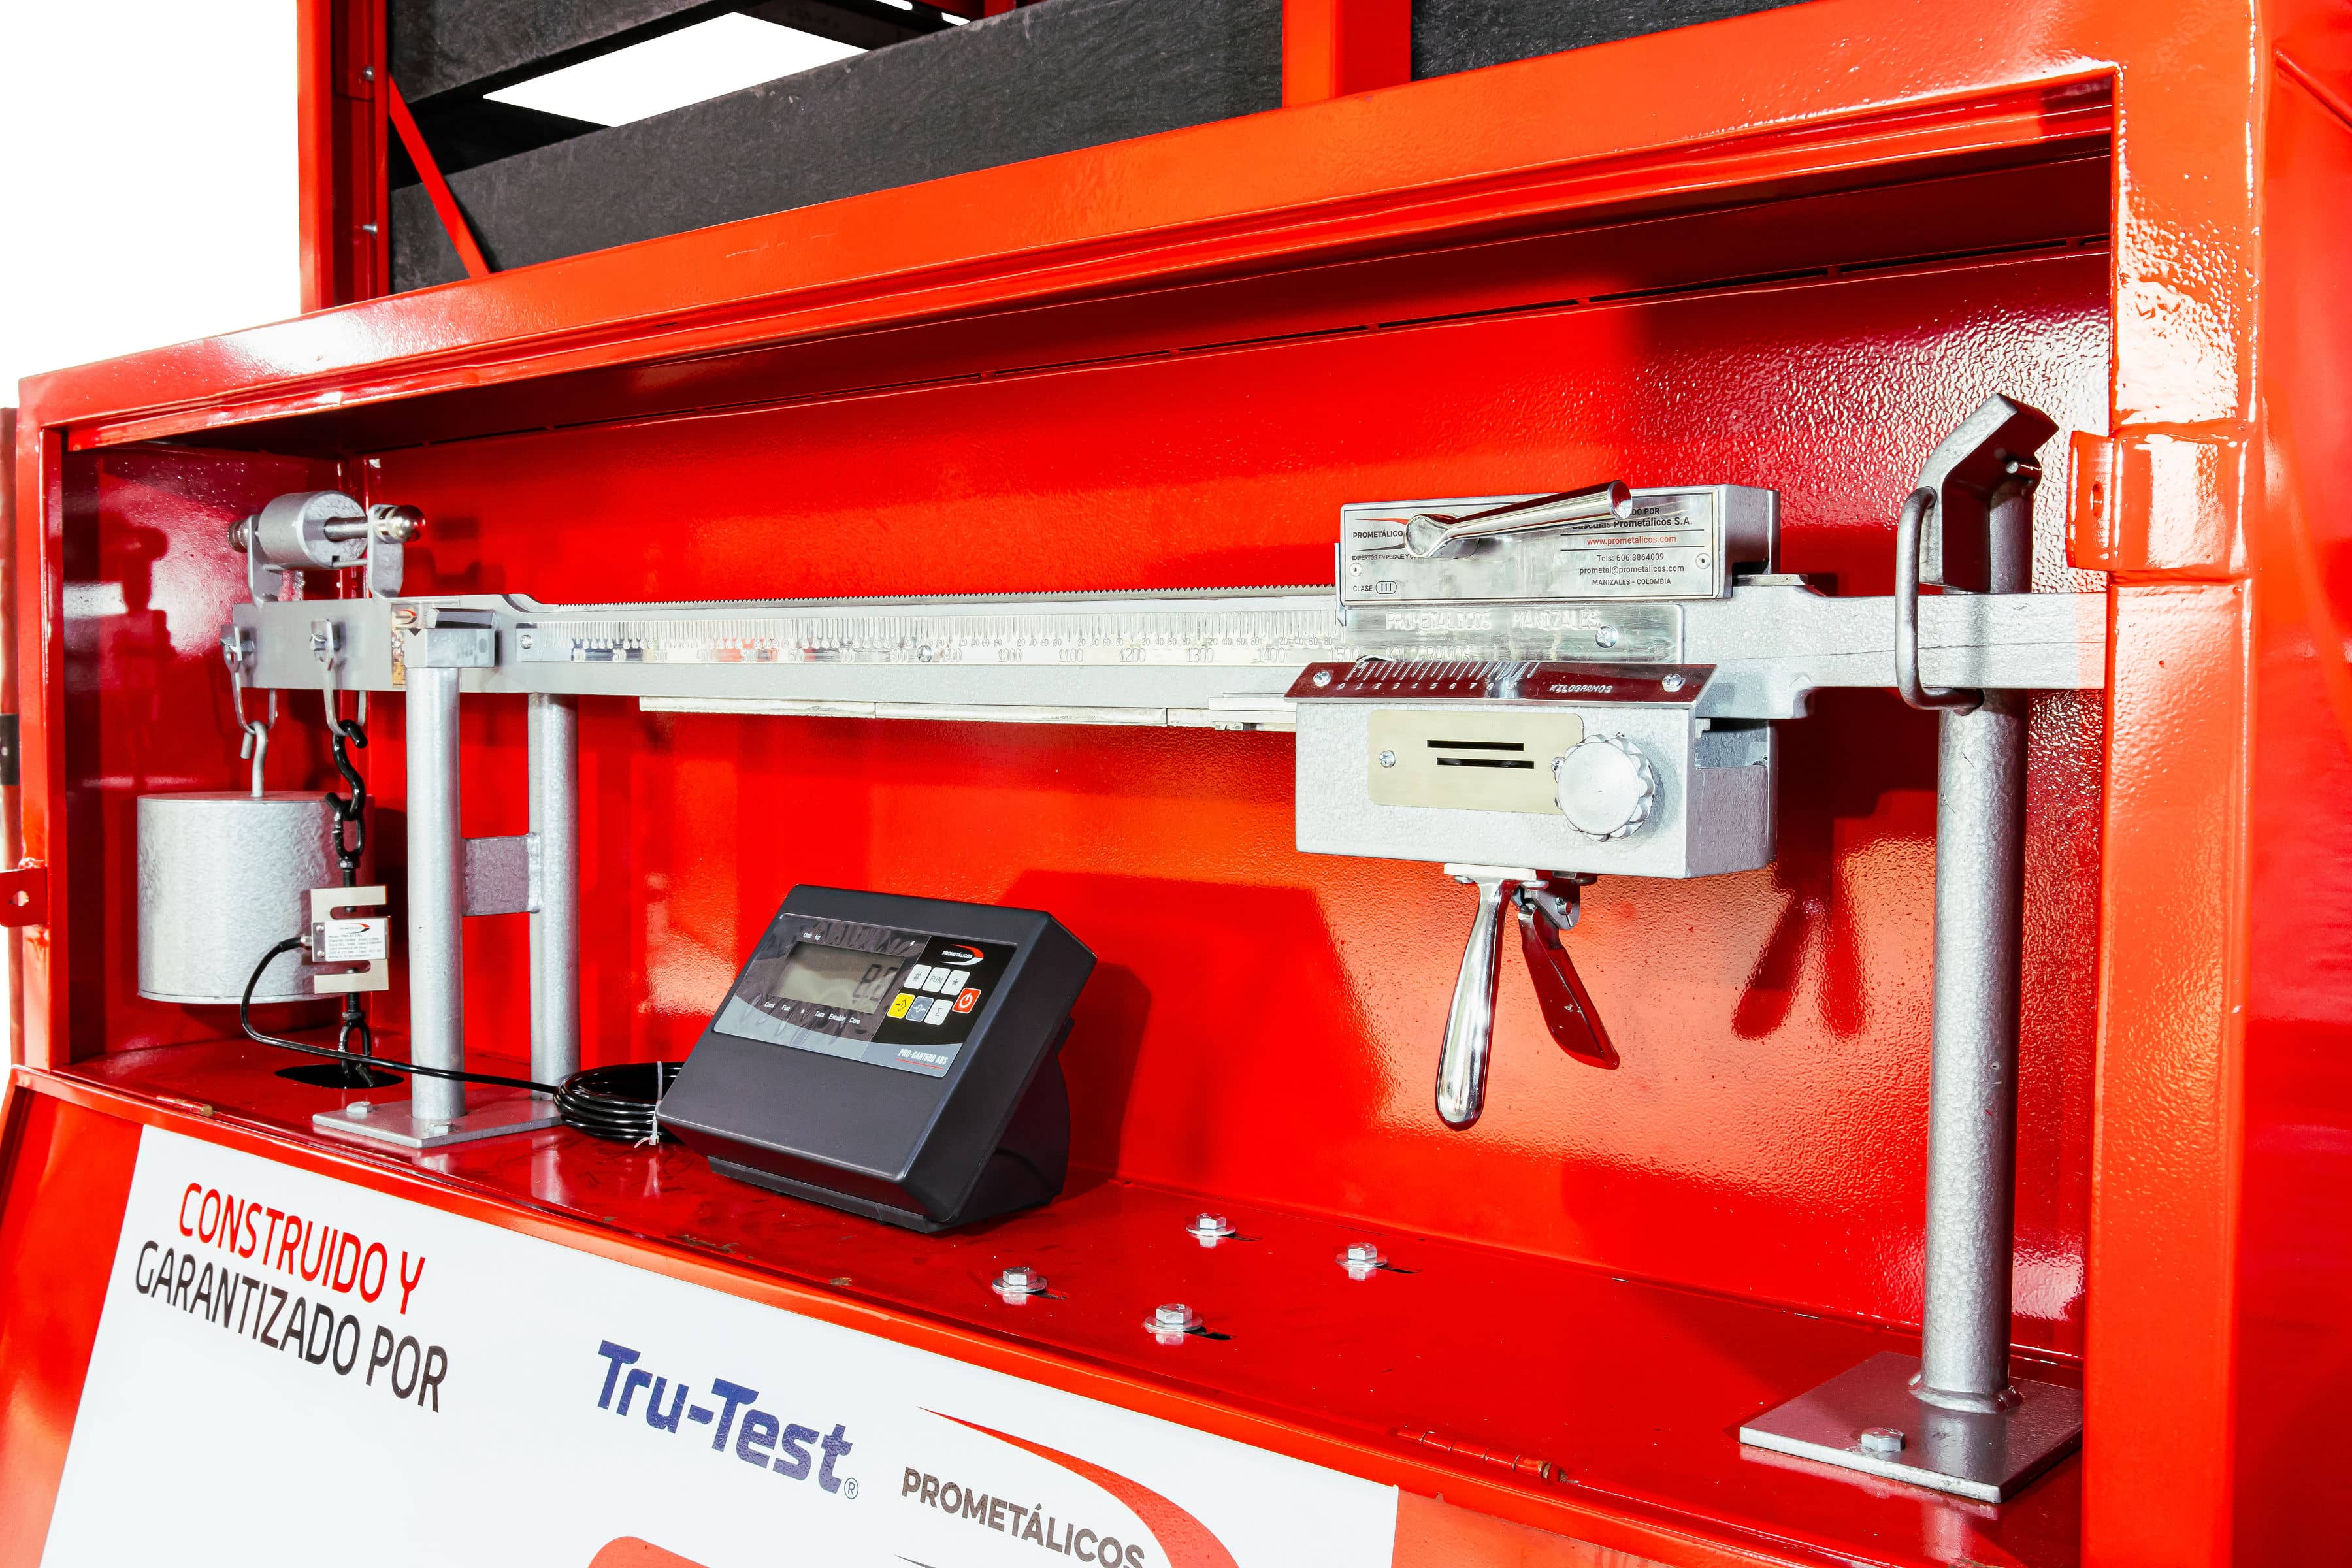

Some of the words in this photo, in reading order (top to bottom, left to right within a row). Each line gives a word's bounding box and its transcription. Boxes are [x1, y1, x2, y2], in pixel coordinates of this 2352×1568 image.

[1674, 516, 1693, 525] S.A.
[1352, 529, 1404, 539] PROMETÁLICO
[1587, 535, 1677, 546] www.prometalicos.com
[1597, 554, 1614, 563] Tels:
[1632, 553, 1665, 561] 8864009
[1579, 564, 1685, 575] prometal@prometalicos.com
[1078, 638, 1086, 647] 20
[1142, 638, 1151, 646] 20
[1156, 638, 1164, 646] 40
[1168, 638, 1177, 646] 60
[1182, 638, 1191, 646] 80
[1209, 637, 1218, 646] 20
[1223, 637, 1232, 646] 40
[1237, 637, 1245, 646] 60
[1251, 637, 1260, 646] 80
[1280, 637, 1288, 646] 20
[1295, 637, 1304, 646] 40
[1309, 637, 1318, 646] 60
[1324, 637, 1333, 646] 80
[998, 648, 1022, 662] 1000
[1059, 648, 1083, 662] 1100
[1120, 647, 1146, 662] 1200
[1186, 647, 1213, 663] 1300
[1257, 647, 1286, 663] 1400
[1548, 683, 1614, 694] KILOGRAMOS
[930, 975, 944, 984] FUN
[849, 1017, 861, 1025] Cero
[179, 1183, 388, 1303] CONSTRUIDO
[400, 1250, 426, 1315] Y
[135, 1240, 361, 1376] GARANTIZADO
[365, 1325, 448, 1414] POR
[597, 1339, 853, 1494] Tru-Test
[901, 1466, 1145, 1568] PROMETÁLICOS
